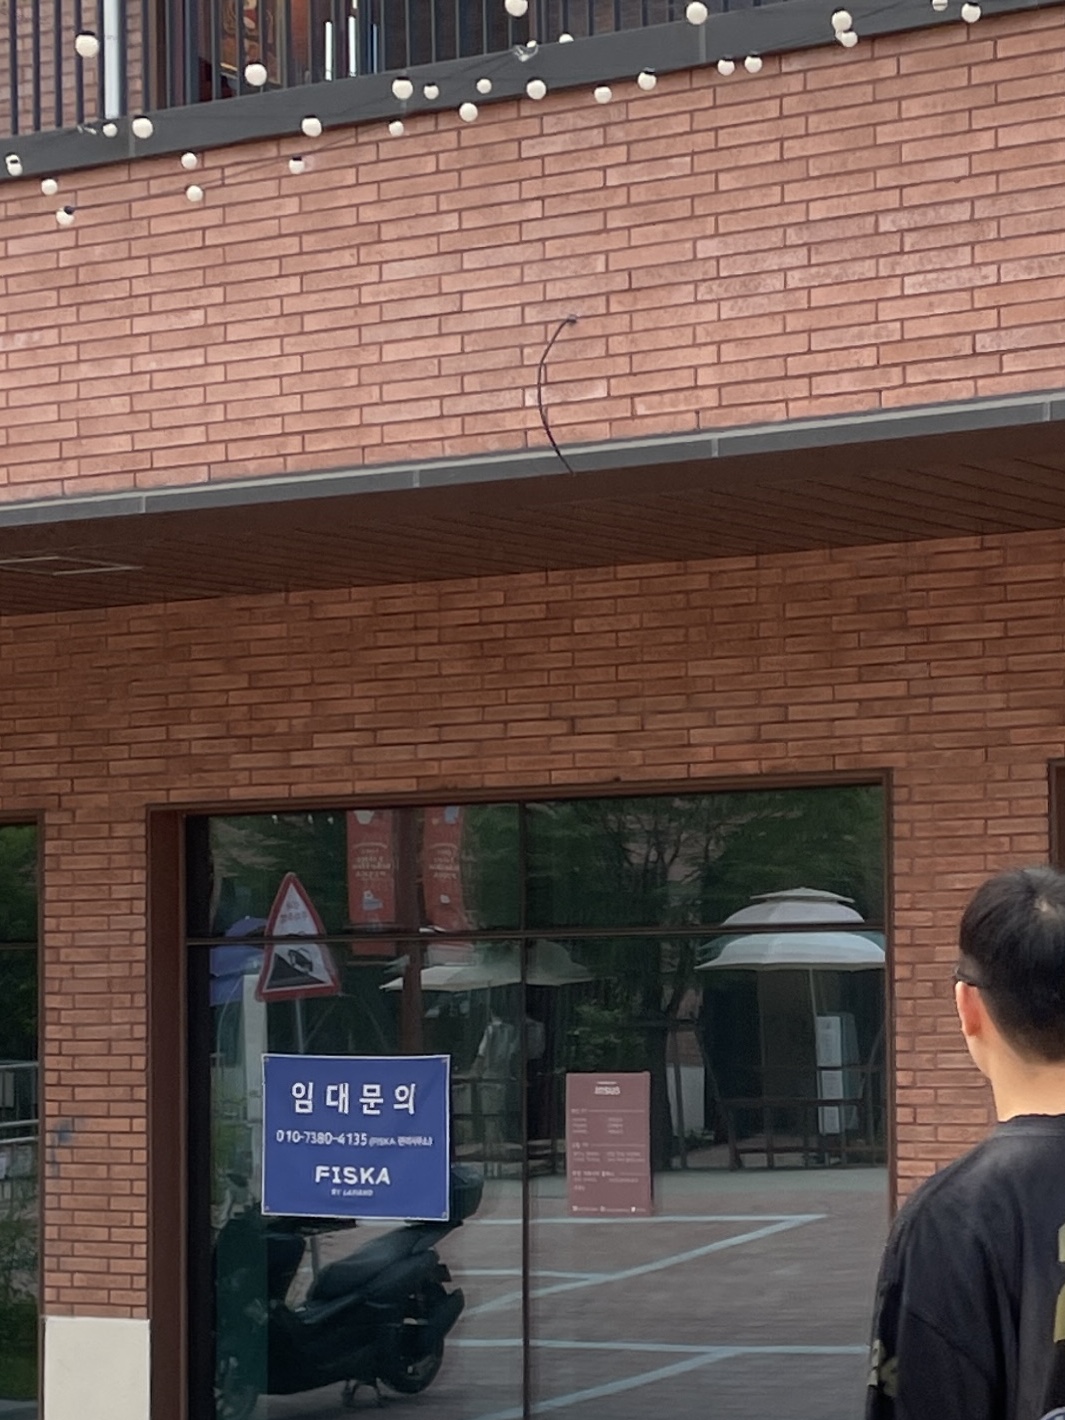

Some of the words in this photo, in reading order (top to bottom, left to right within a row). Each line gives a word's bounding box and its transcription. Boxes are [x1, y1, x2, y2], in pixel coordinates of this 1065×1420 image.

[291, 1081, 416, 1115] 임대문의
[276, 1129, 368, 1147] 010-7380-4135
[315, 1165, 391, 1186] FISKA
